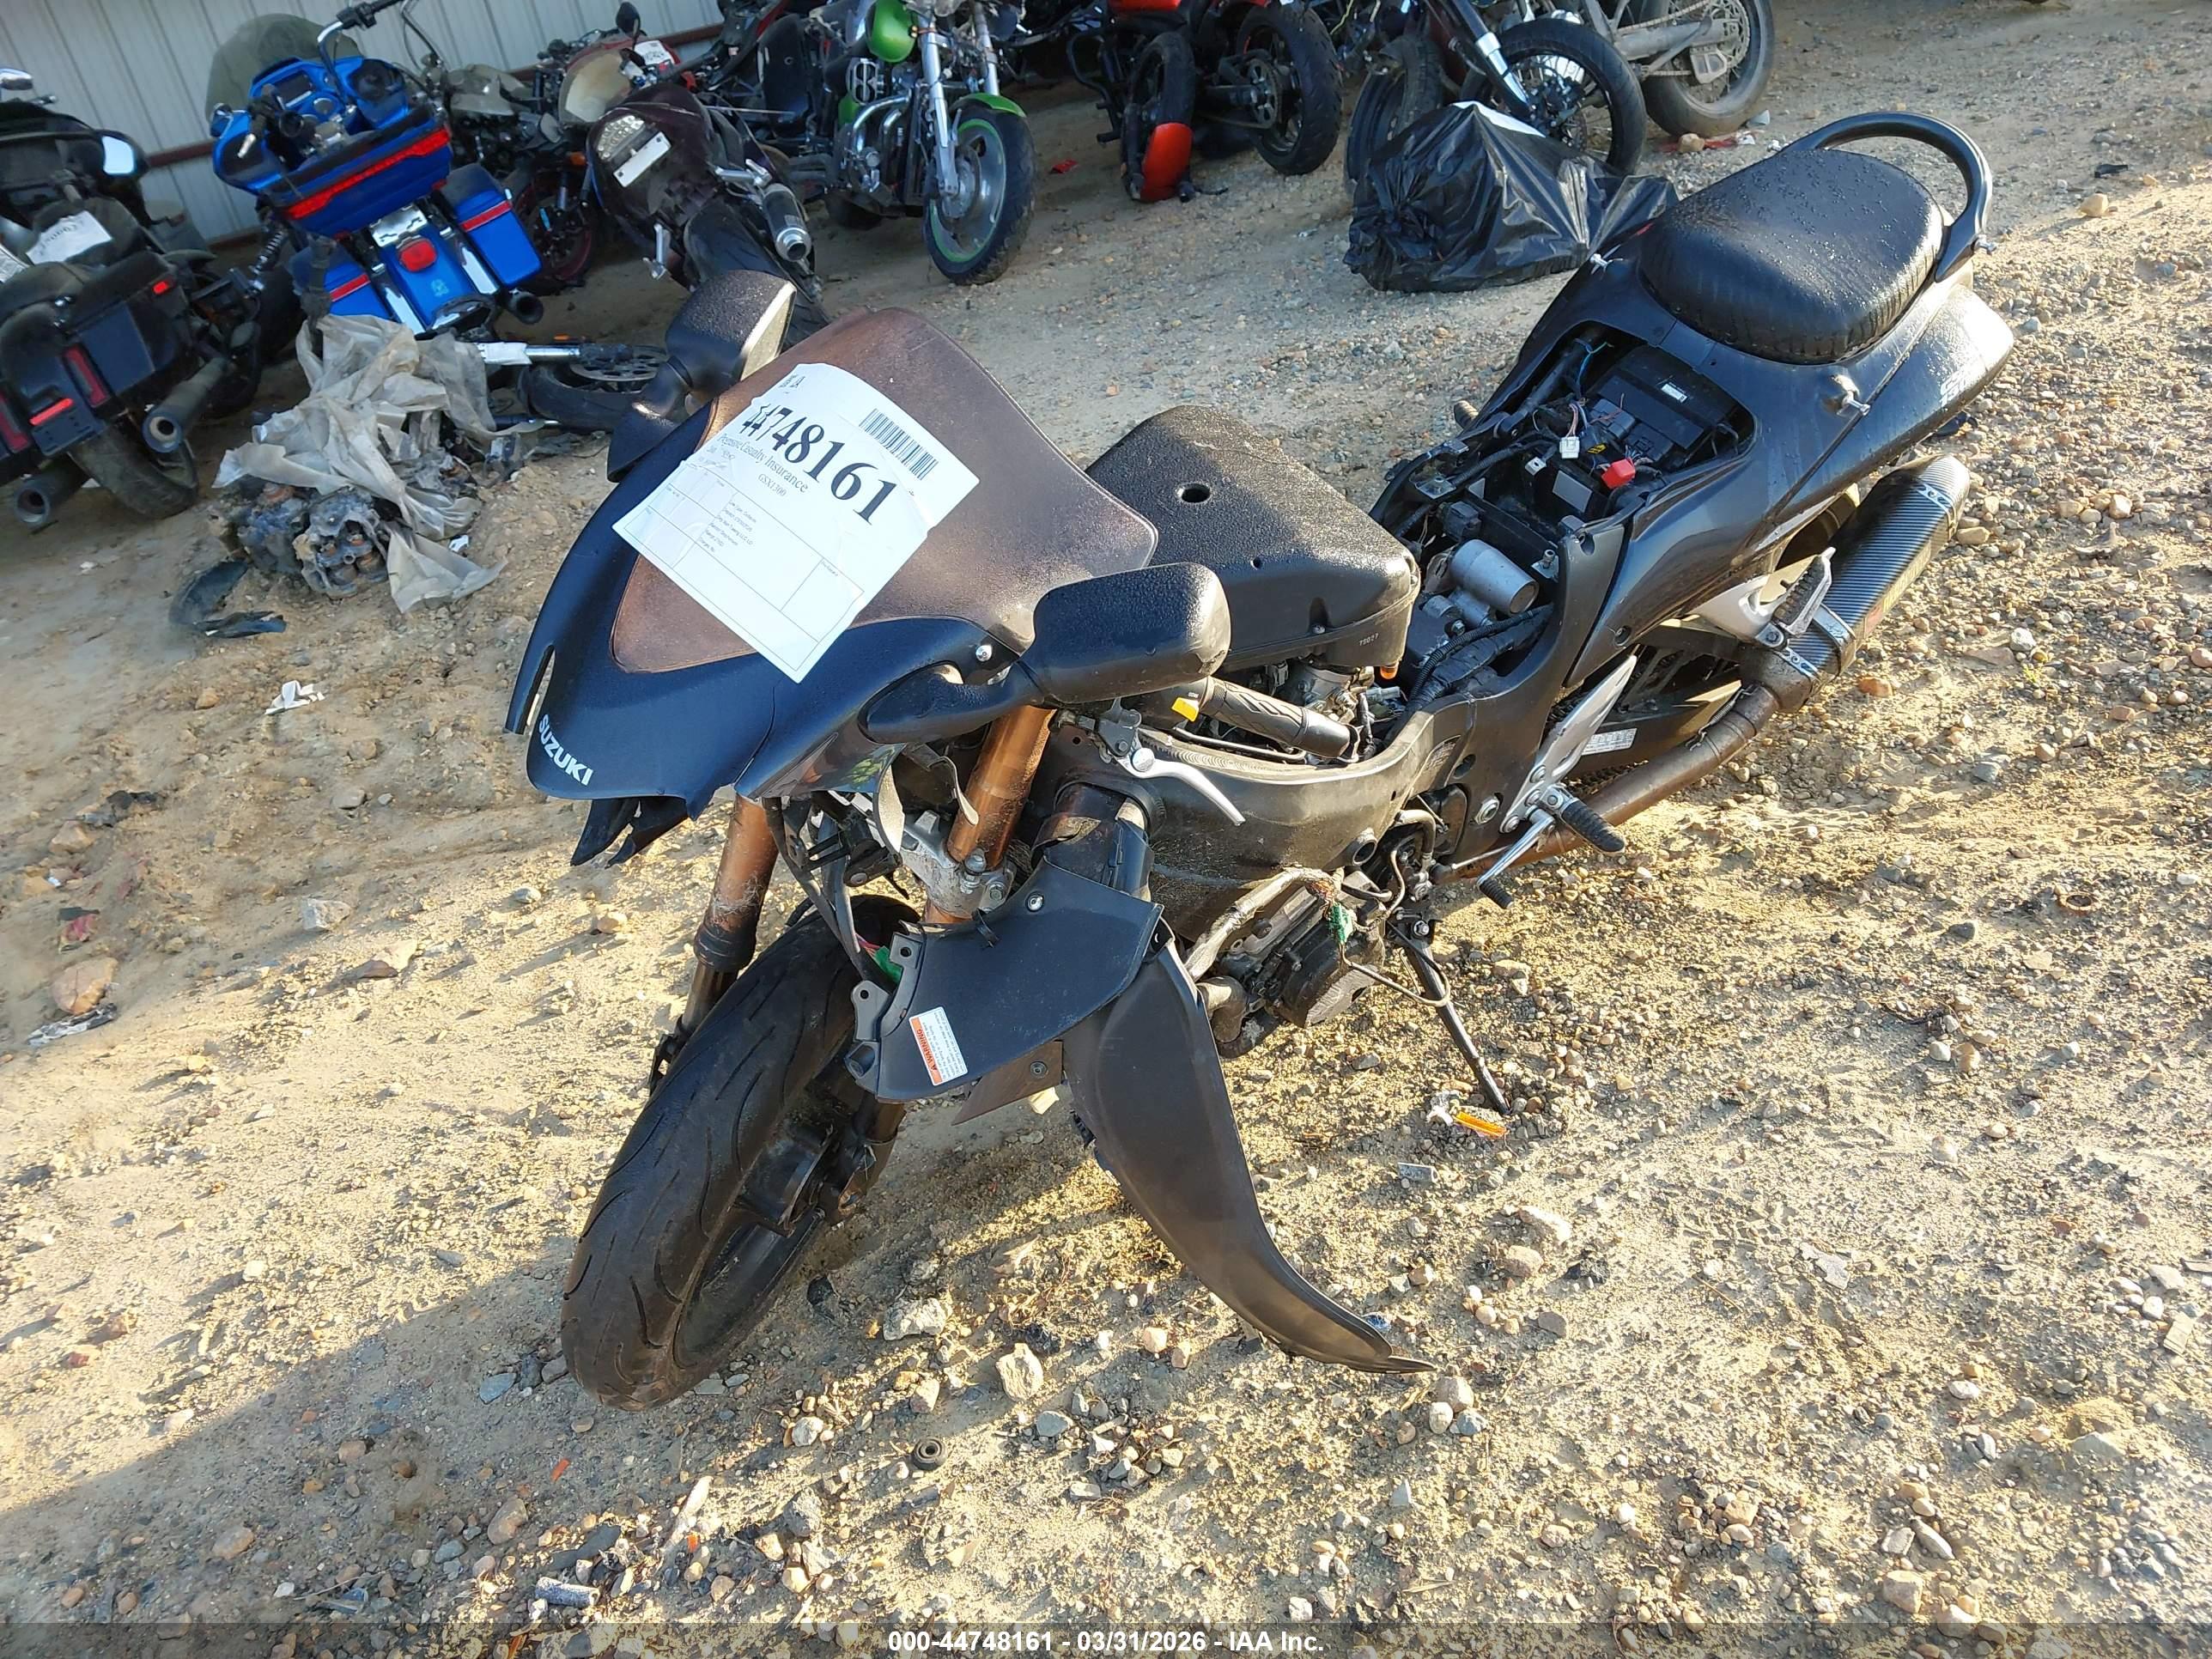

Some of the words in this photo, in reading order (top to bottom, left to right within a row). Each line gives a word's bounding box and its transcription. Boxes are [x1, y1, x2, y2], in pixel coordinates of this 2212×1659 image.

[757, 473, 787, 496] GSX1300
[764, 453, 809, 493] Insurance
[538, 714, 594, 786] SUZUKI
[916, 1029, 934, 1064] WARNING
